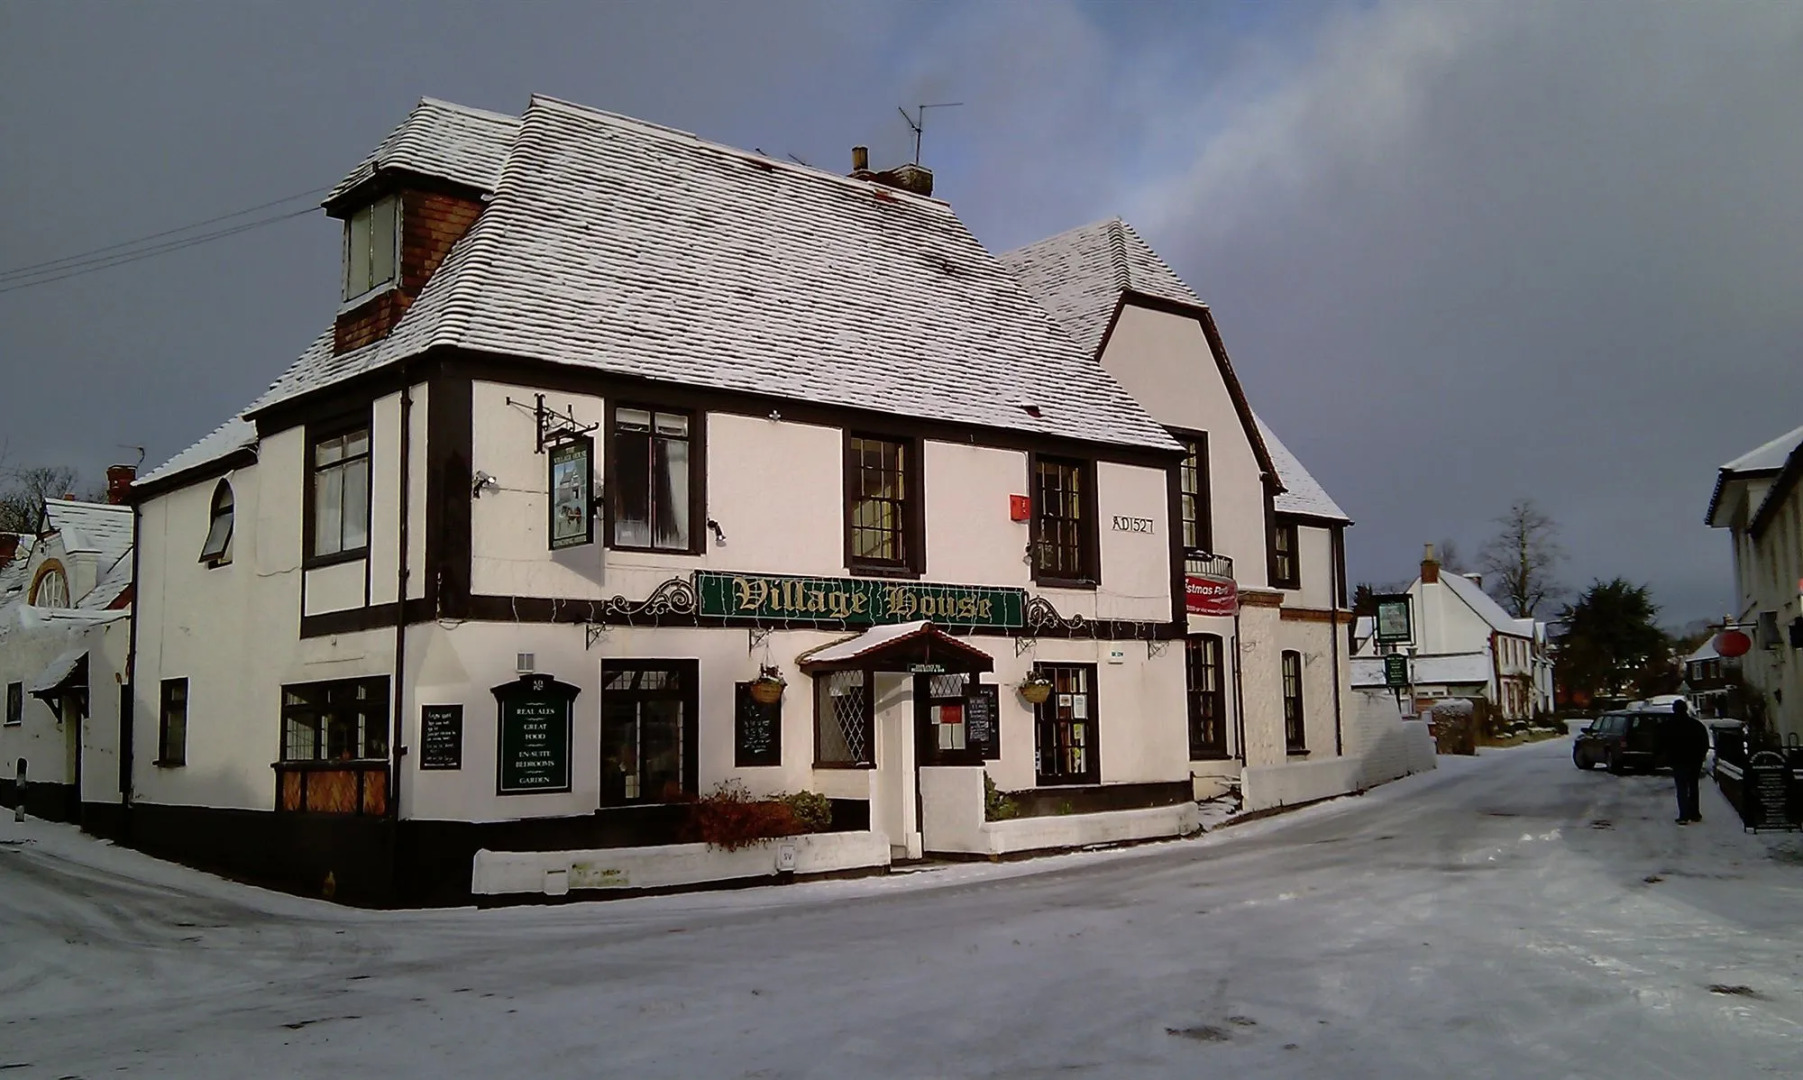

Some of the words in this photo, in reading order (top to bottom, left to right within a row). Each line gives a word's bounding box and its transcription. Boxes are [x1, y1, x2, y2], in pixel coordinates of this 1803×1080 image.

[732, 576, 869, 619] Village
[885, 586, 993, 620] House
[515, 760, 555, 769] BEDROOMS
[519, 776, 550, 784] GARDEN
